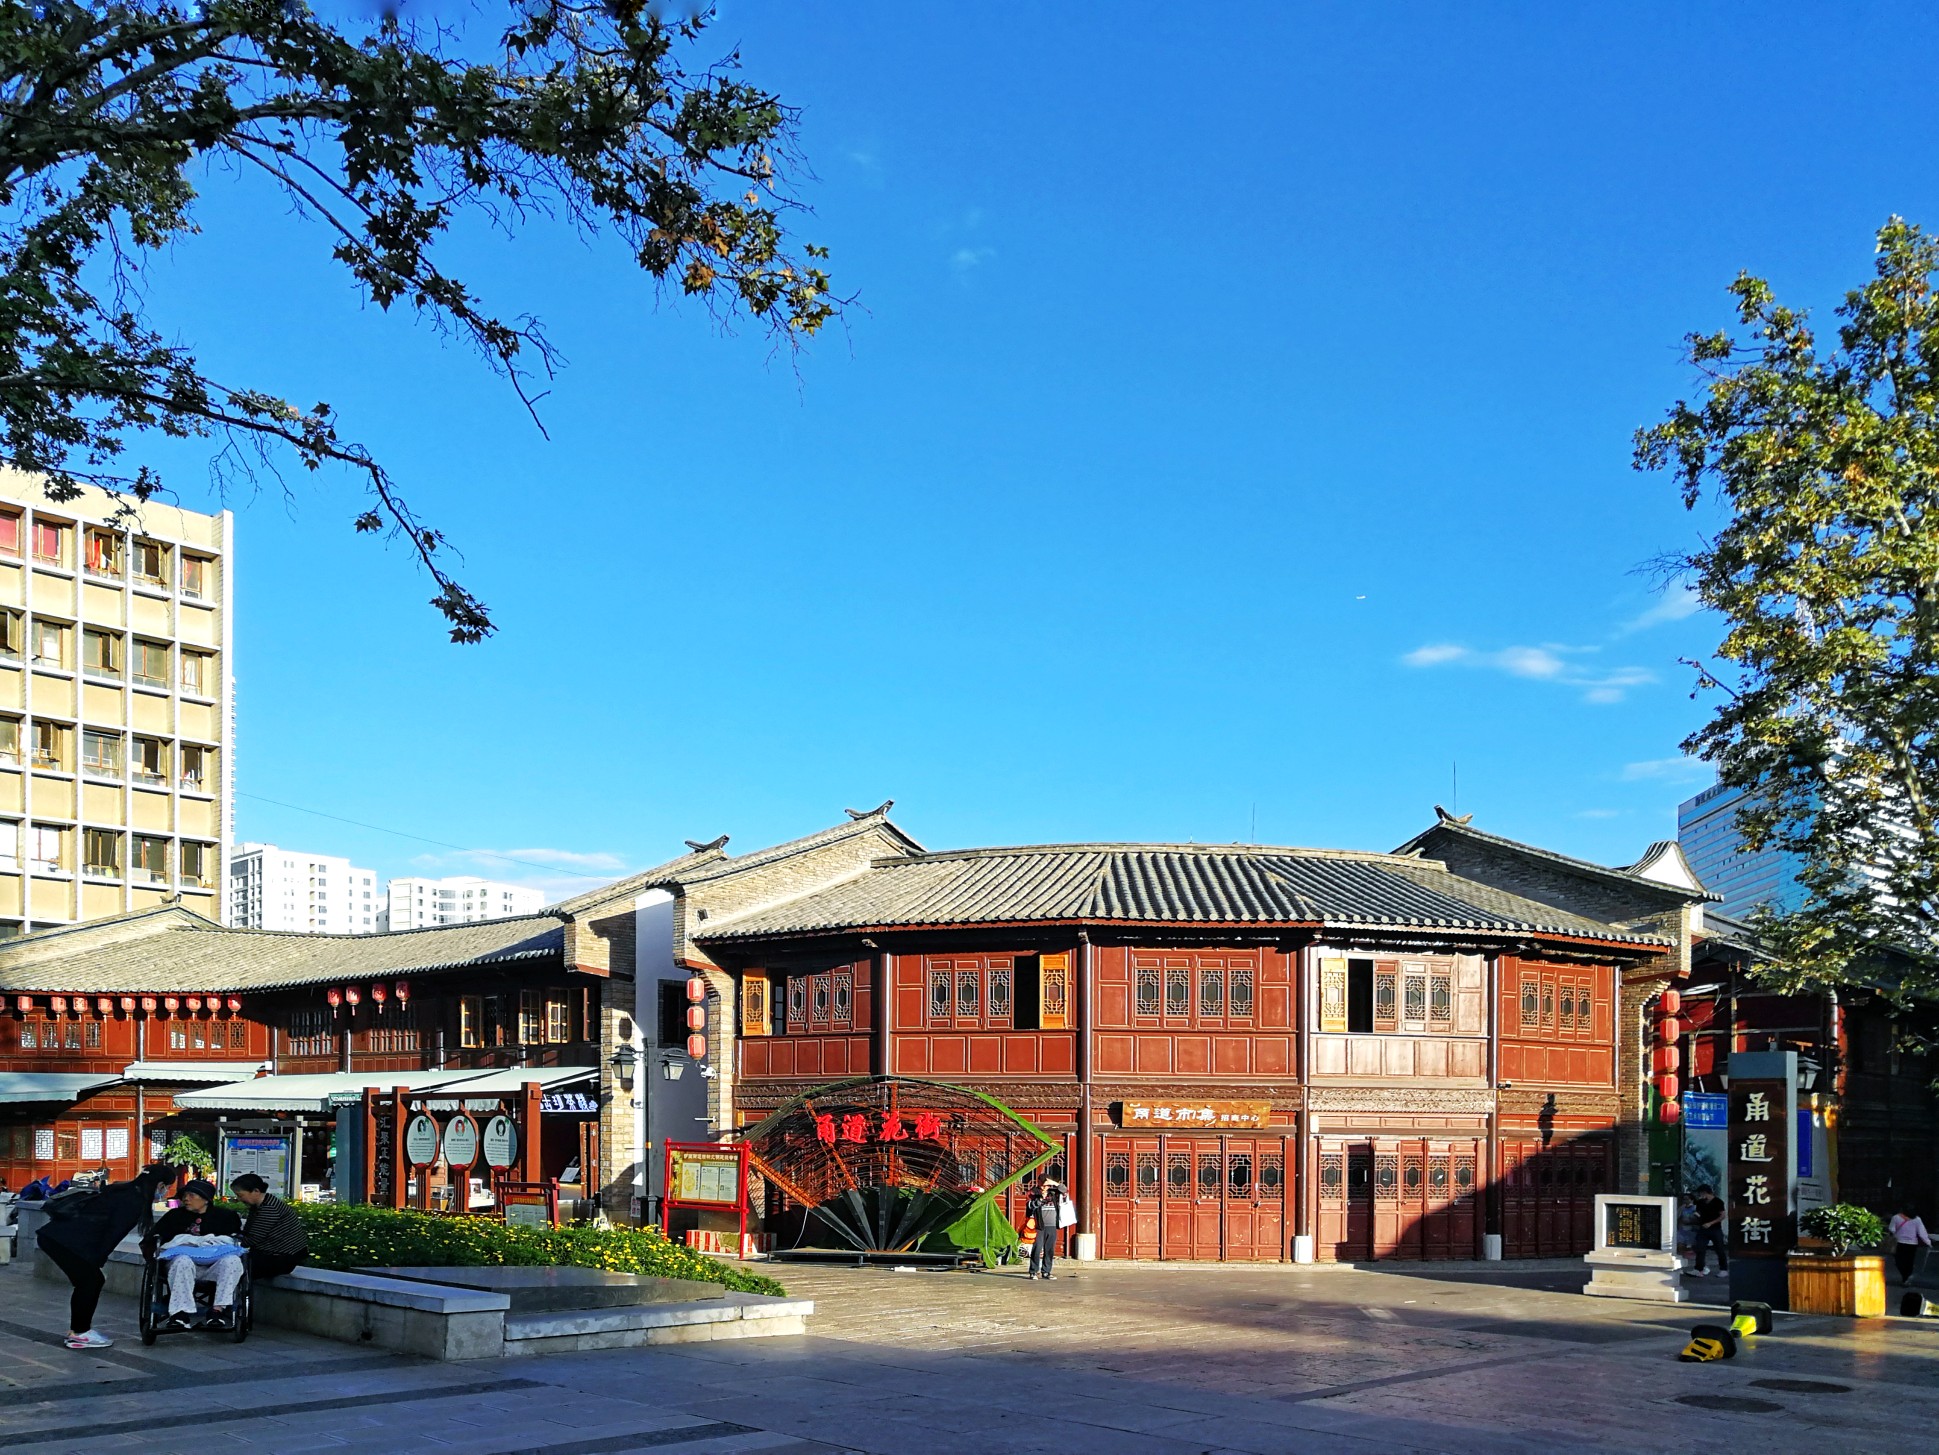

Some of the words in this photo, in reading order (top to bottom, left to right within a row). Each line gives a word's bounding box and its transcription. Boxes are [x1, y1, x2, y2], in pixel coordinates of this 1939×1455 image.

[817, 1110, 943, 1144] 甬道花街
[1132, 1106, 1216, 1121] 甬道市集
[379, 1116, 391, 1195] 汇聚正能量
[1740, 1092, 1773, 1244] 甬道花街
